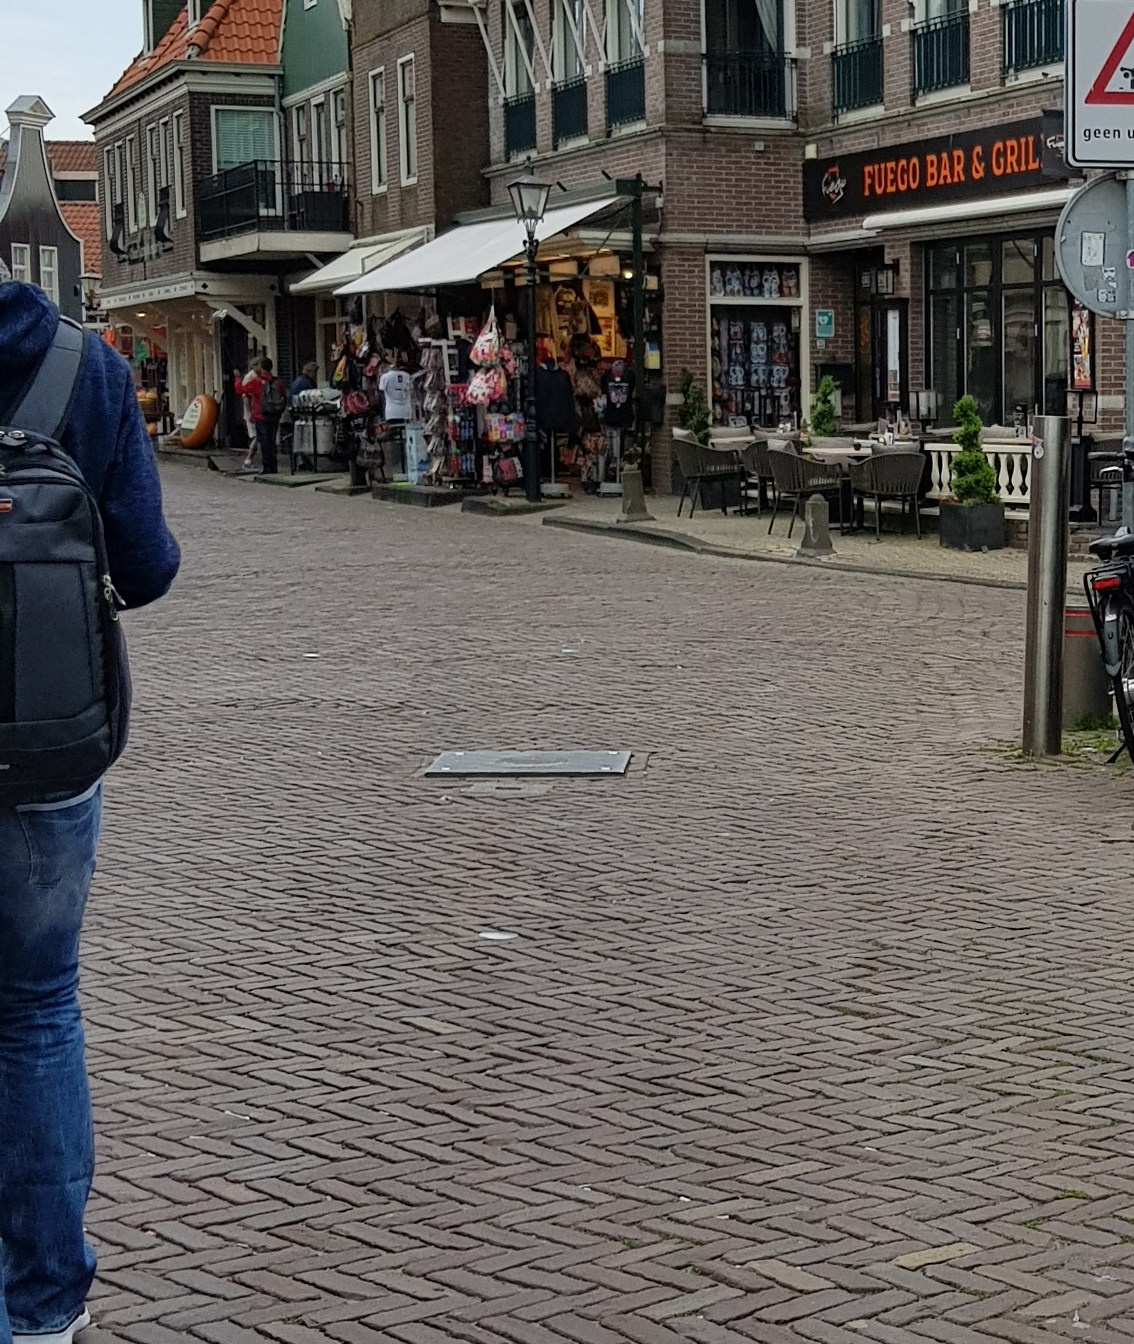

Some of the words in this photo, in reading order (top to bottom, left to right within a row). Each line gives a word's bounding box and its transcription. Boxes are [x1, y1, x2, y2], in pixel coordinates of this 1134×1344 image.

[1083, 128, 1121, 142] geen
[863, 156, 920, 197] FUEGO
[926, 148, 966, 187] BAR
[971, 145, 985, 180] &
[991, 134, 1043, 177] GRIL
